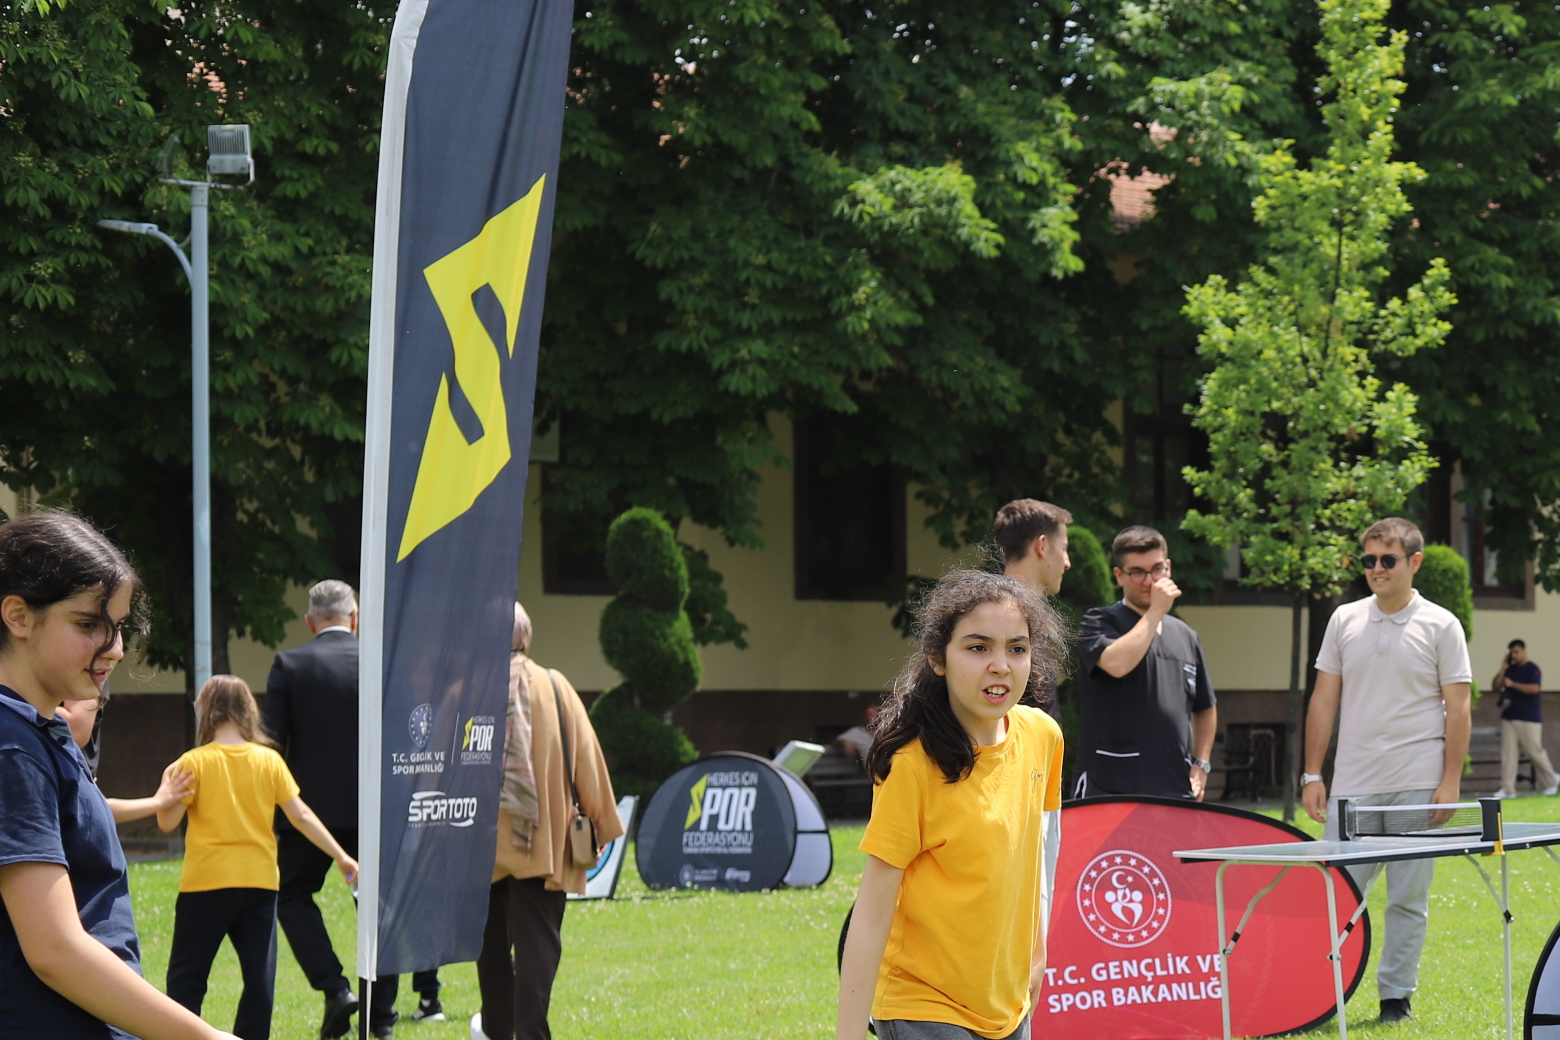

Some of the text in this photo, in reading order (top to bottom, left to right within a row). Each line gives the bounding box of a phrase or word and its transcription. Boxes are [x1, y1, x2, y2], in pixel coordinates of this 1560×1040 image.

[392, 753, 408, 763] T.C.
[434, 751, 445, 761] VE
[392, 765, 414, 775] SPOR
[684, 773, 757, 831] SPOR
[682, 831, 754, 847] FEDERASYONU
[1044, 965, 1086, 987] T.C.
[1091, 952, 1191, 982] GENÇLİK
[1048, 976, 1222, 1014] SPOR BAKANLIĞ
